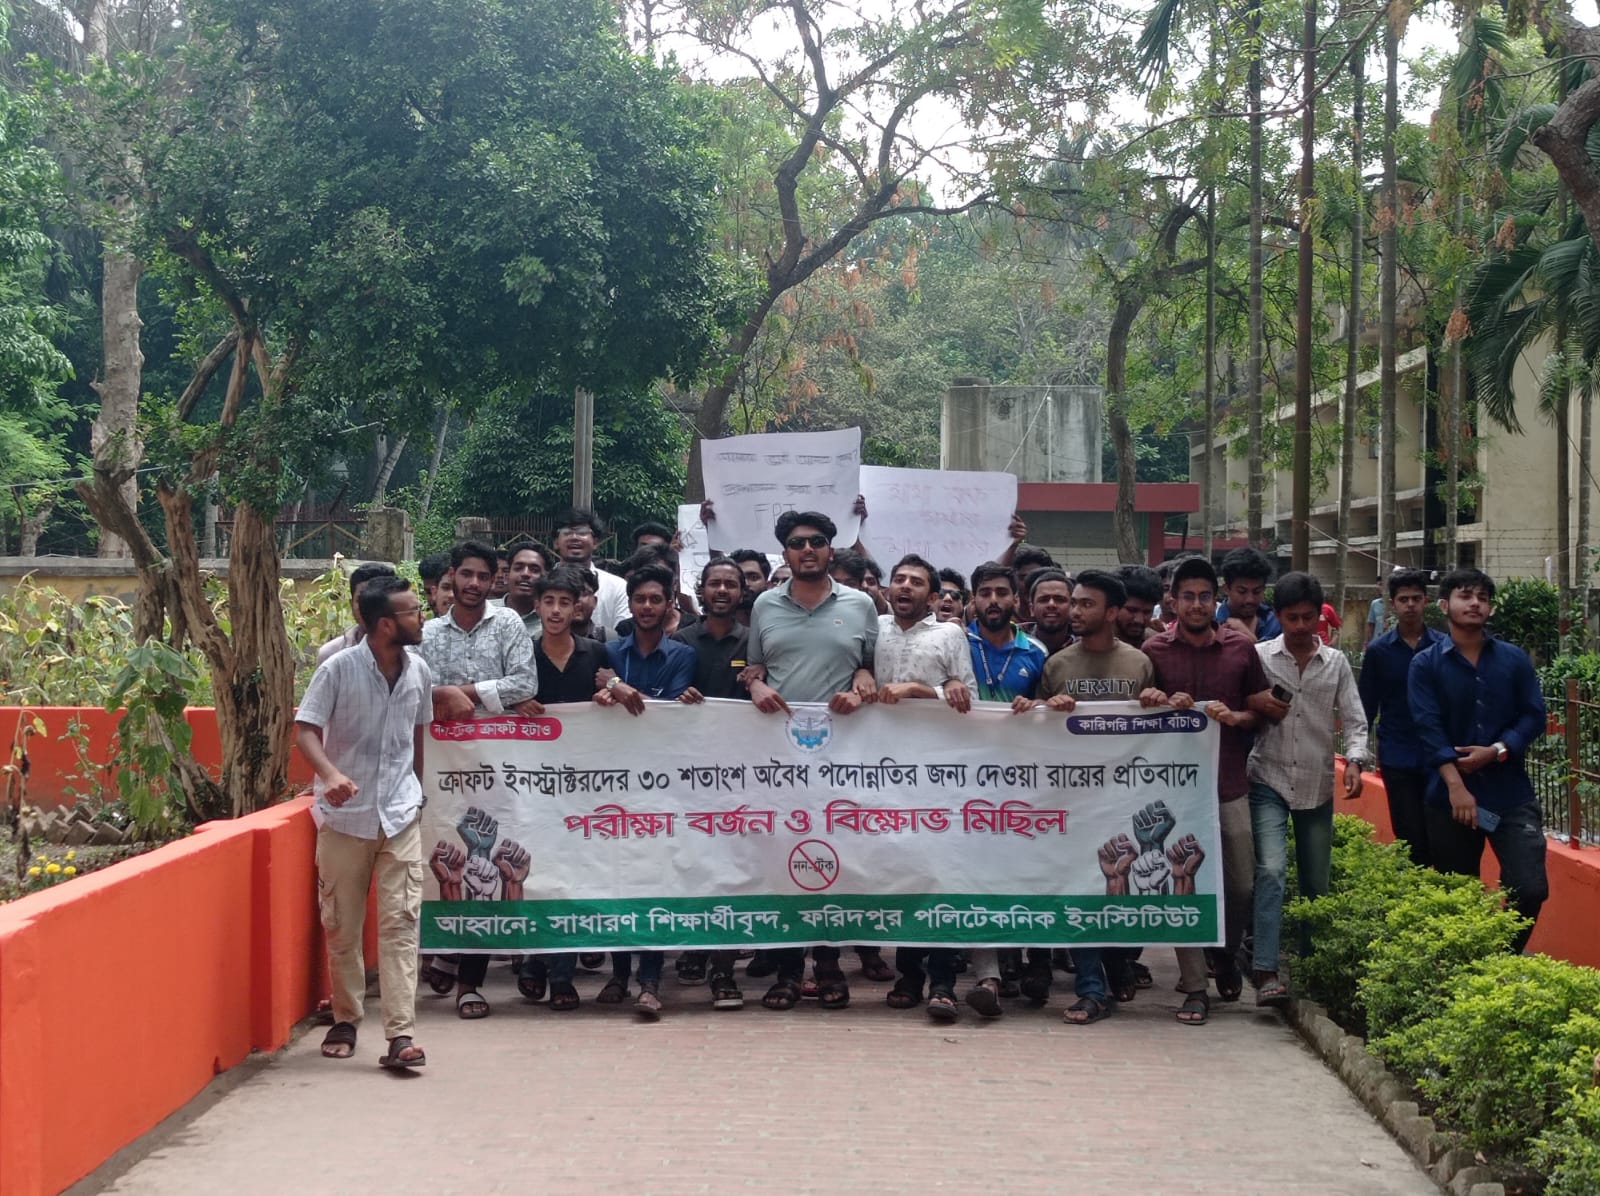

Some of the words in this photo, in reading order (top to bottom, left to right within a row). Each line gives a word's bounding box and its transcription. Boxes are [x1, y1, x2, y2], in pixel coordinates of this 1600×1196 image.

[1065, 678, 1136, 696] VERSITY
[479, 720, 517, 736] ক্রাফট
[520, 721, 551, 737] হটাও
[1078, 717, 1128, 732] কারিগরি
[1132, 717, 1162, 730] শিক্ষা
[1167, 713, 1201, 728] বাঁচাও
[437, 762, 495, 795] ক্রাফট
[501, 762, 630, 797] ইনস্ট্রাক্টরদের
[637, 768, 670, 791] ৩০
[678, 763, 746, 792] শতাংশ
[752, 757, 810, 789] অবৈধ
[817, 756, 918, 792] পদোন্নতির
[925, 763, 968, 787] জন্য
[976, 760, 1039, 788] দেওয়া
[1046, 763, 1106, 788] রায়ের
[1112, 756, 1200, 789] প্রতিবাদে
[562, 803, 676, 839] পরীক্ষা
[687, 804, 776, 837] বর্জন
[784, 808, 812, 834] ও
[822, 799, 951, 835] বিক্ষোভ
[960, 799, 1067, 839] মিছিল
[549, 911, 639, 934] সাধারণ
[647, 904, 791, 938] শিক্ষার্থীবৃন্দ,
[798, 906, 902, 933] ফরিদপুর
[914, 904, 1057, 930] পলিটেকনিক
[1064, 905, 1202, 932] ইনস্টিটিউট
